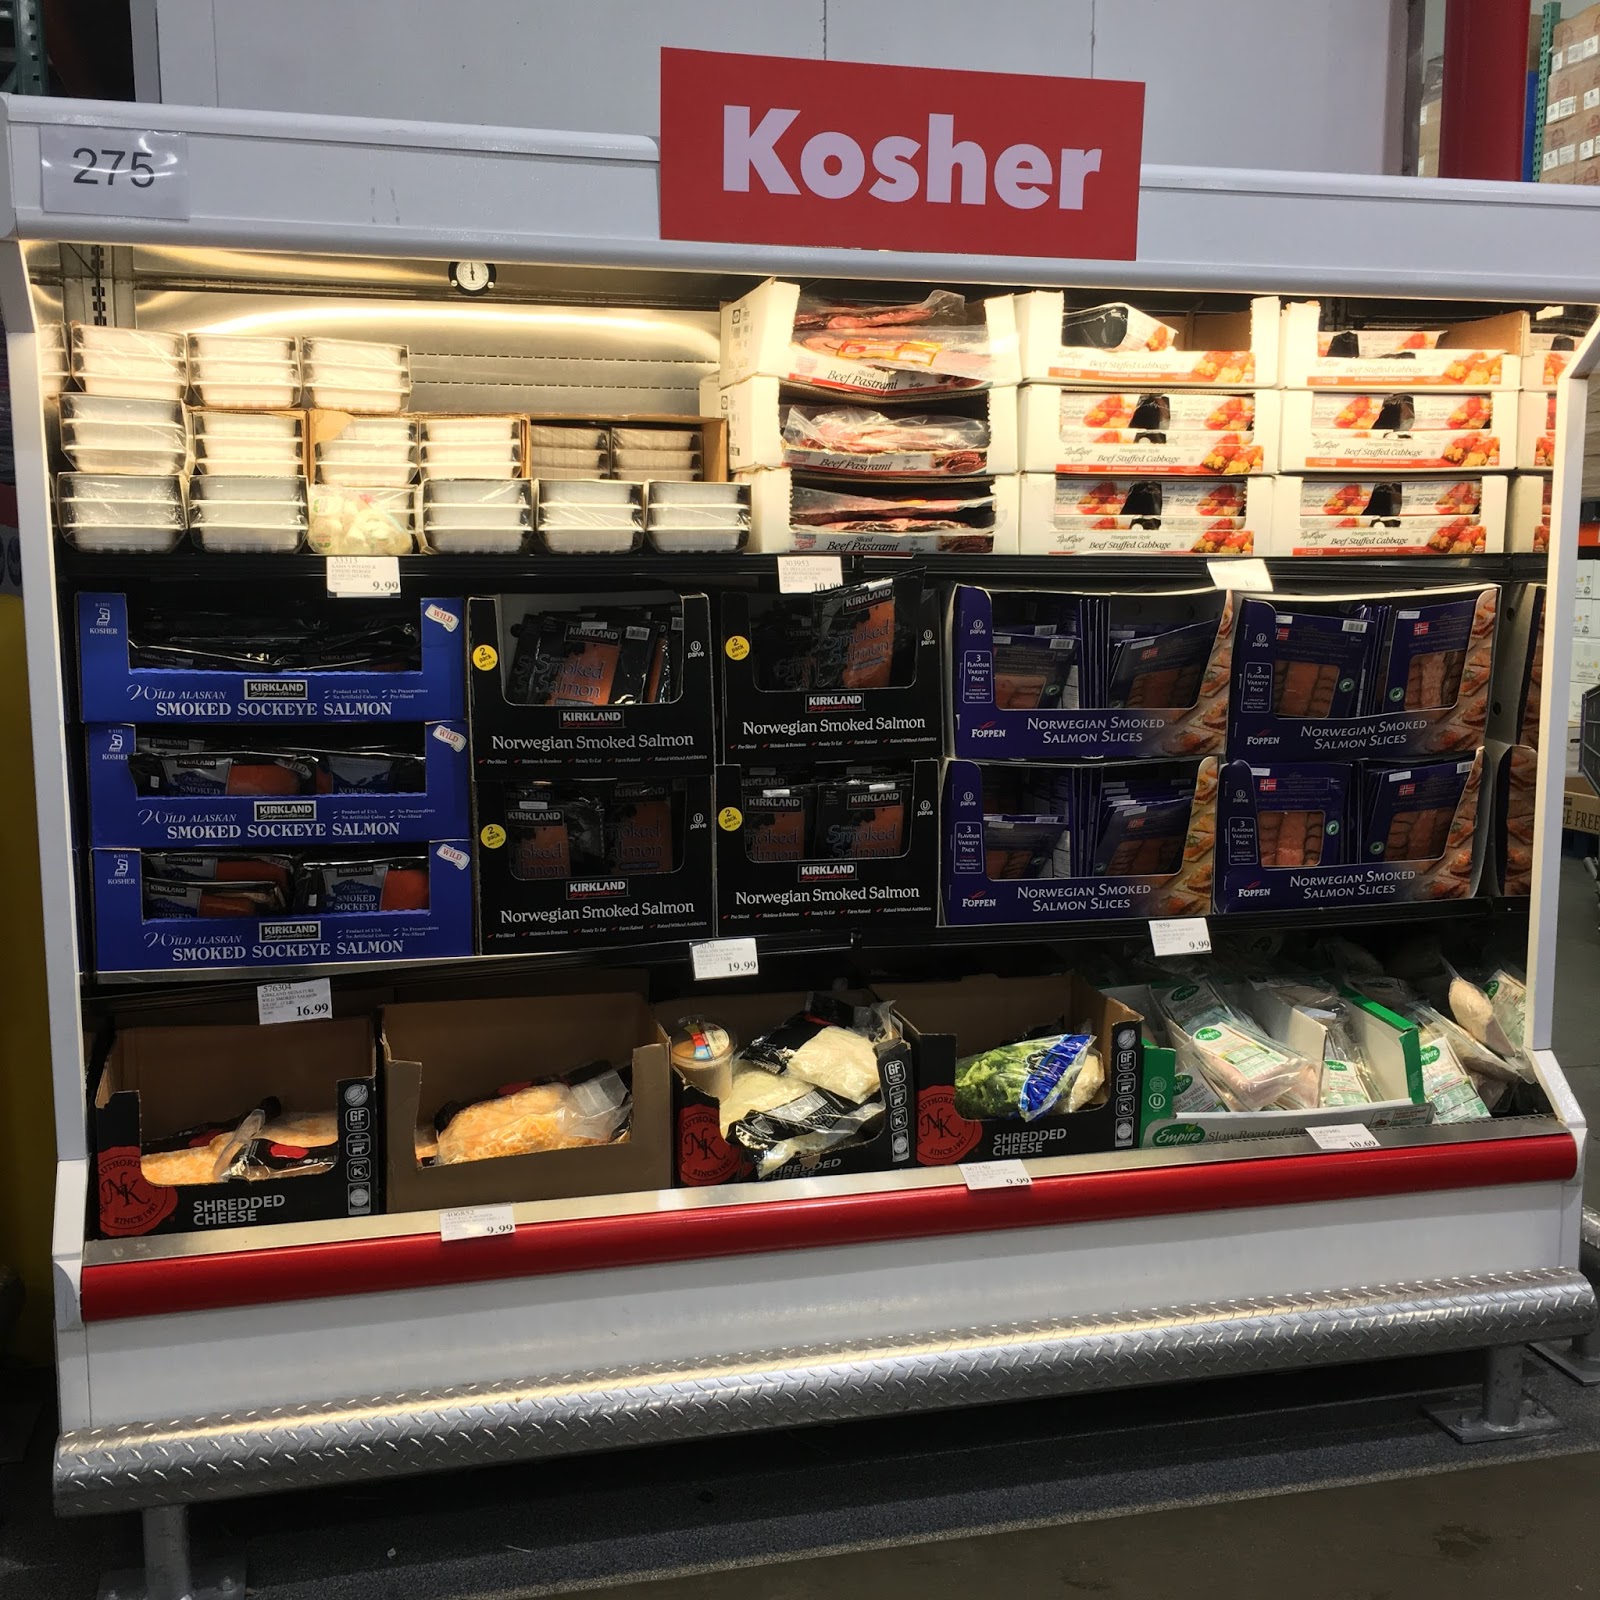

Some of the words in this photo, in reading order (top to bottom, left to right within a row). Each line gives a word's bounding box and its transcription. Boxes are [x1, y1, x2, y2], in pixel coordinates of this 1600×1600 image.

[723, 104, 1102, 210] Kosher
[73, 147, 155, 188] 275
[827, 370, 852, 384] Beef
[853, 375, 898, 390] Pastrami
[1344, 448, 1361, 456] Beef
[1362, 448, 1391, 456] Stuffed
[1393, 448, 1423, 457] Cabbage
[1097, 454, 1114, 463] Beef
[1115, 454, 1145, 463] Stuffed
[1147, 455, 1180, 464] Cabbage
[820, 459, 847, 469] Beef
[846, 461, 893, 471] Pastrami
[827, 541, 851, 551] Beef
[851, 542, 899, 551] Pastrami
[1089, 541, 1107, 549] Beef
[1108, 541, 1136, 549] Stuffed
[1137, 541, 1171, 549] Cabbage
[1331, 537, 1348, 545] Beef
[1349, 537, 1376, 545] Stuffed
[1377, 537, 1408, 546] Cabbage
[373, 581, 398, 591] 9.99
[433, 609, 453, 623] WILD
[89, 627, 117, 635] KOSHER
[732, 638, 738, 646] 2
[732, 644, 744, 652] pack
[479, 653, 492, 662] pack
[688, 651, 704, 659] parve
[250, 682, 304, 692] KIRKLAND
[180, 691, 226, 700] ALASKAN
[809, 696, 861, 706] KIRKLAND
[156, 702, 231, 716] SMOKED
[238, 702, 318, 716] SOCKEYE
[324, 702, 392, 716] SALMON
[563, 712, 621, 721] KIRKLAND
[743, 721, 818, 736] Norwegian
[820, 718, 873, 732] Smoked
[876, 717, 925, 730] Salmon
[1028, 718, 1107, 730] NORWEGIAN
[1111, 717, 1164, 728] SMOKED
[1301, 726, 1375, 737] NORWEGIAN
[1379, 720, 1427, 731] SMOKED
[439, 729, 459, 743] WILD
[972, 729, 1006, 738] FOPPEN
[1043, 732, 1097, 743] SALMON
[1101, 731, 1143, 742] SLICES
[492, 736, 573, 751] Norwegian
[576, 735, 636, 749] Smoked
[638, 733, 694, 747] Salmon
[1247, 736, 1280, 745] FOPPEN
[1314, 739, 1366, 750] SALMON
[1370, 734, 1407, 745] SLICES
[260, 804, 312, 814] KIRKLAND
[725, 809, 731, 817] 2
[190, 814, 236, 822] ALASKAN
[724, 816, 737, 824] pack
[1575, 810, 1600, 831] FREE
[167, 825, 241, 839] SMOKED
[247, 823, 326, 838] SOCKEYE
[332, 822, 399, 836] SALMON
[690, 822, 706, 830] parve
[487, 833, 500, 842] pack
[443, 848, 462, 861] WILD
[339, 866, 373, 874] KIRKLAND
[802, 865, 854, 875] KIRKLAND
[1290, 876, 1363, 888] NORWEGIAN
[1367, 870, 1415, 882] SMOKED
[570, 881, 625, 892] KIRKLAND
[1018, 887, 1094, 898] NORWEGIAN
[1099, 884, 1150, 896] SMOKED
[1303, 888, 1354, 899] SALMON
[1358, 884, 1395, 895] SLICES
[736, 891, 810, 906] Norwegian
[813, 888, 866, 902] Smoked
[869, 886, 919, 899] Salmon
[1238, 888, 1271, 897] FOPPEN
[337, 894, 375, 902] SMOKED
[962, 899, 996, 907] FOPPEN
[334, 903, 377, 911] SOCKEYE
[1033, 900, 1086, 912] SALMON
[1091, 898, 1130, 909] SLICES
[500, 908, 579, 924] Norwegian
[582, 903, 638, 918] Smoked
[641, 902, 694, 915] Salmon
[264, 925, 317, 934] KIRKLAND
[195, 935, 242, 945] ALASKAN
[1188, 940, 1210, 950] 9.99
[173, 947, 246, 961] SMOKED
[252, 943, 330, 958] SOCKEYE
[337, 940, 404, 955] SALMON
[728, 960, 756, 972] 19.99
[263, 983, 292, 993] 576304
[296, 1002, 328, 1016] 16.99
[1120, 1053, 1132, 1062] GF
[888, 1064, 901, 1074] GF
[350, 1111, 365, 1122] GF
[993, 1128, 1067, 1146] SHREDDED
[1156, 1128, 1201, 1145] Empire
[1208, 1131, 1235, 1142] Slow
[1239, 1128, 1286, 1138] Roasted
[993, 1141, 1043, 1156] CHEESE
[1350, 1140, 1376, 1148] 10.69
[929, 1147, 952, 1155] SINCE
[194, 1194, 285, 1213] SHREDDED
[193, 1210, 256, 1226] CHEESE
[487, 1224, 513, 1234] 9.99
